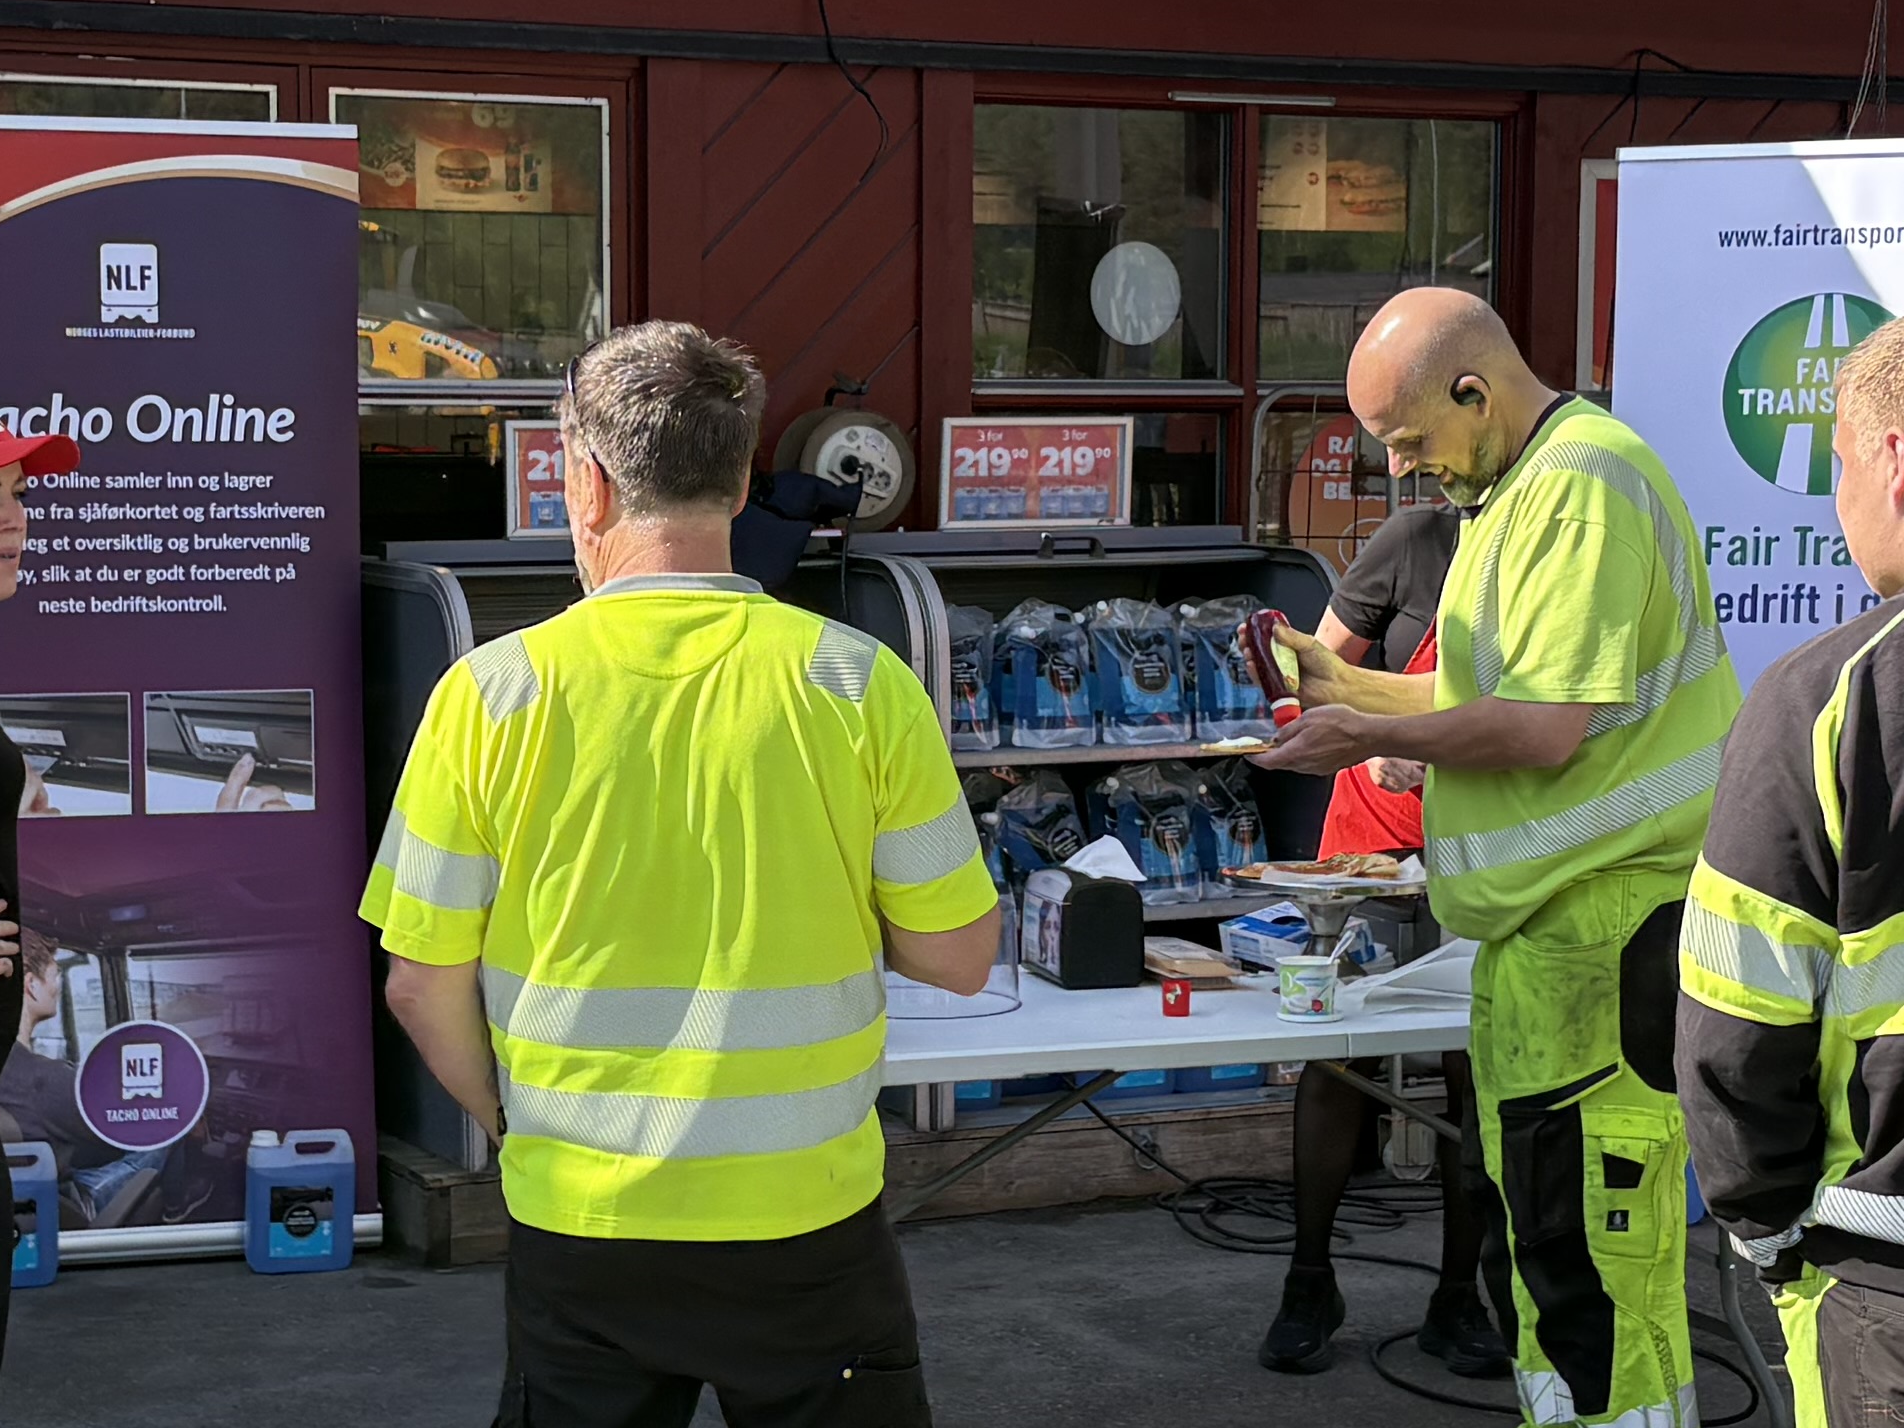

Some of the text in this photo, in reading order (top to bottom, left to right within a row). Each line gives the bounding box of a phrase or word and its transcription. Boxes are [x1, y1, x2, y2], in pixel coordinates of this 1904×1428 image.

[106, 265, 152, 291] NLF
[1737, 387, 1837, 416] TRANS
[126, 392, 295, 443] Online
[977, 429, 985, 442] 3
[1062, 429, 1089, 441] 3 for
[527, 449, 564, 481] 21
[43, 471, 101, 489] Online
[105, 471, 162, 489] samler
[167, 471, 194, 489] inn
[198, 475, 220, 491] og
[224, 471, 274, 491] lagrer
[50, 504, 74, 520] fra
[78, 502, 179, 522] sjåførkortet
[183, 506, 205, 522] og
[209, 501, 325, 520] fartsskriveren
[53, 537, 71, 551] et
[75, 533, 163, 553] oversiktlig
[167, 538, 189, 553] og
[194, 532, 311, 553] brukervennlig
[1705, 525, 1781, 567] Fair
[42, 565, 70, 582] slik
[75, 567, 93, 582] at
[97, 564, 119, 582] du
[123, 568, 142, 582] er
[146, 564, 185, 584] godt
[190, 563, 271, 582] forberedt
[276, 562, 296, 583] på
[38, 594, 227, 614] neste bedriftskontroll.
[1714, 583, 1821, 624] edrift
[1835, 583, 1844, 624] i
[126, 1057, 159, 1078] NLF
[106, 1106, 179, 1123] TACHO ONLINE
